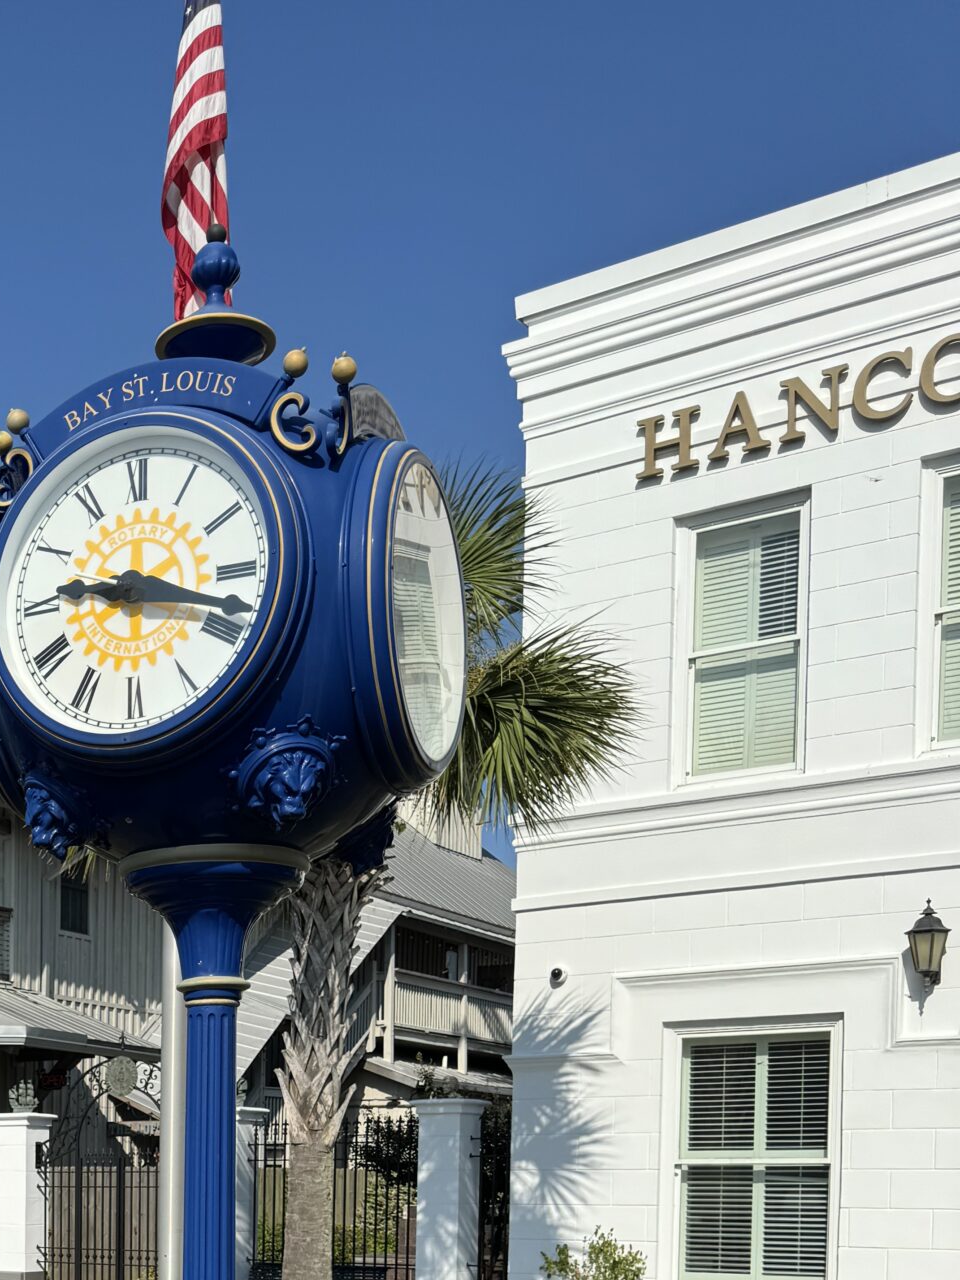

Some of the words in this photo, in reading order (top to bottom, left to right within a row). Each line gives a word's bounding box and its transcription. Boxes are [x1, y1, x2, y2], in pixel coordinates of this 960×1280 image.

[63, 388, 114, 432] BAY
[160, 370, 236, 396] LOUIS
[107, 525, 168, 549] ROTARY
[87, 606, 190, 654] INTERNATIONAL
